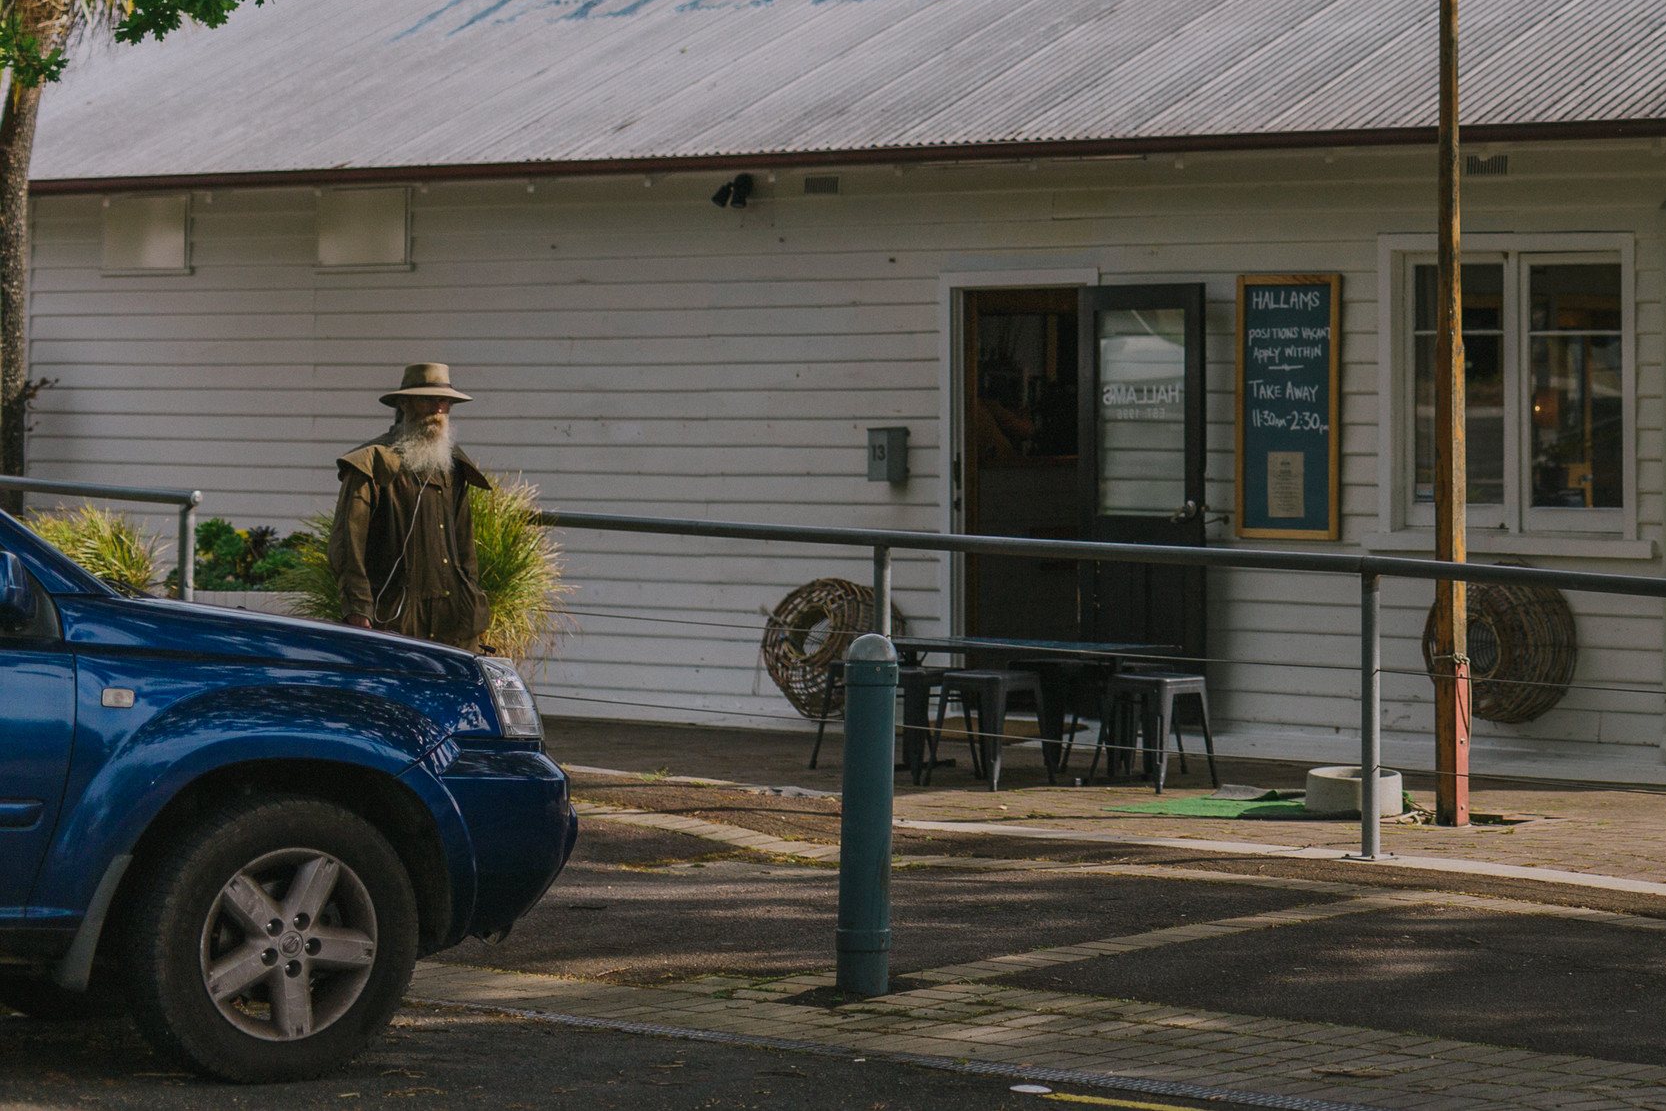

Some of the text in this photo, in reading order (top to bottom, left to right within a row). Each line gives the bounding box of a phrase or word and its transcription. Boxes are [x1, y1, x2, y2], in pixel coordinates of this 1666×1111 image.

[1252, 290, 1320, 311] HALLAMS
[1285, 344, 1322, 359] WITHIN
[871, 444, 886, 462] 13
